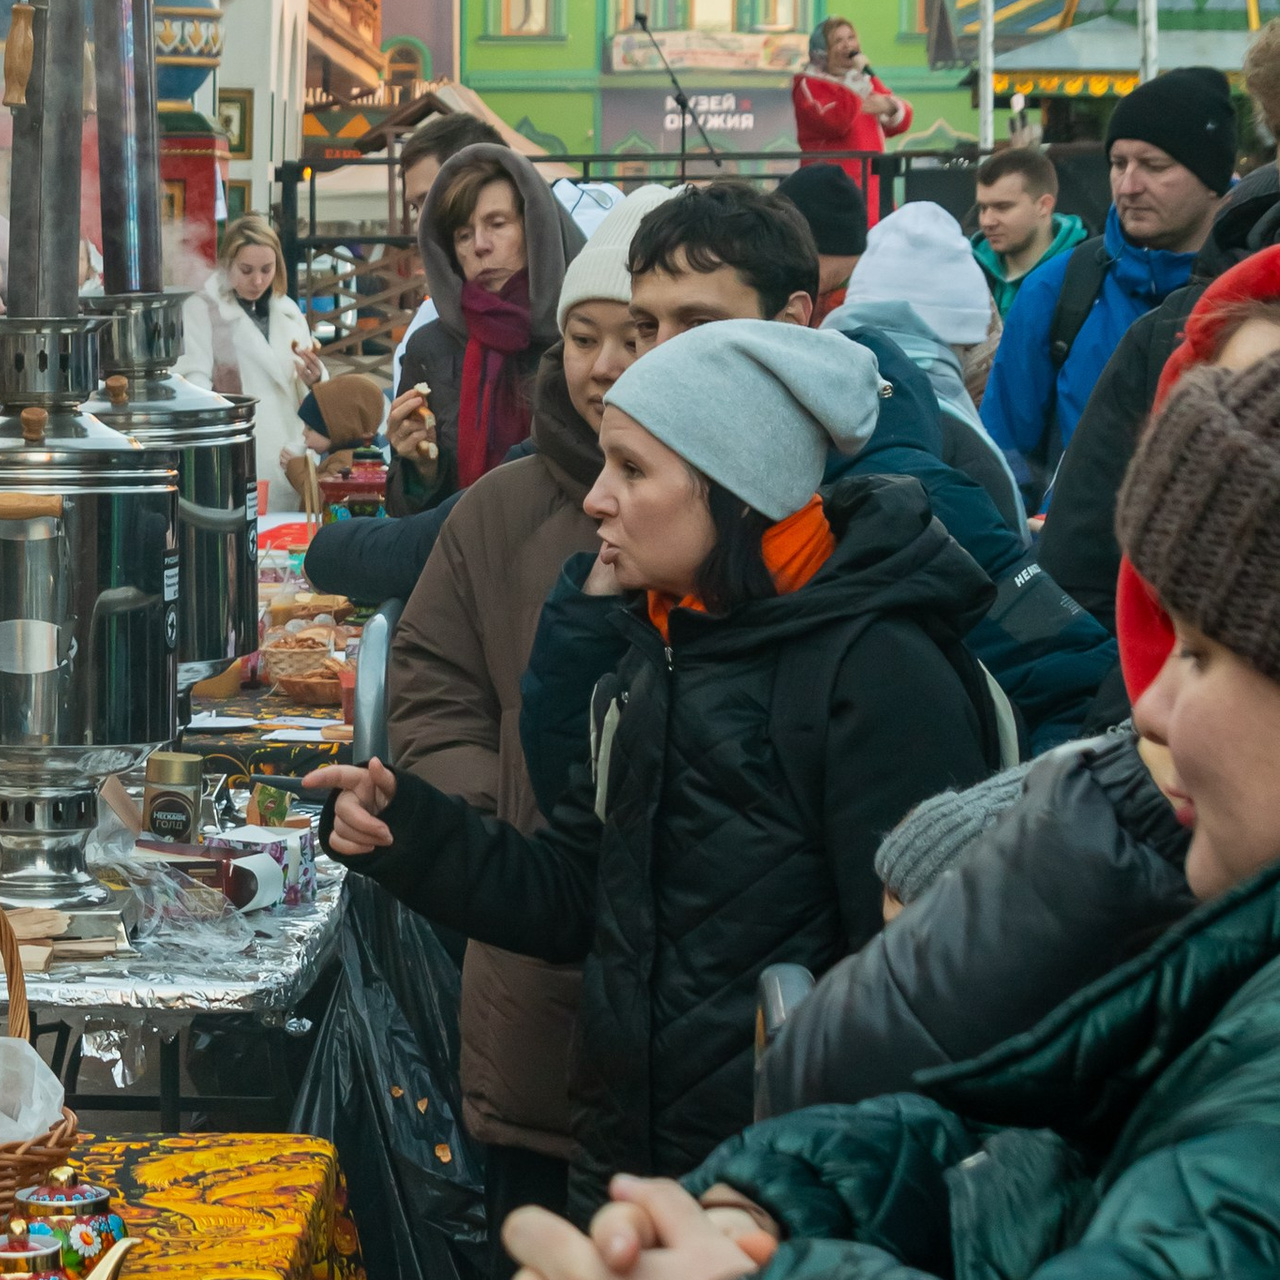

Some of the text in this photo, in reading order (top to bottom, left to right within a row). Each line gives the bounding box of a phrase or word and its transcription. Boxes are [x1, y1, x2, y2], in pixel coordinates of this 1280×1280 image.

[664, 93, 737, 112] МУЗЕЙ
[663, 113, 755, 131] ОРУЖИЯ
[156, 819, 183, 830] ГОЛД
